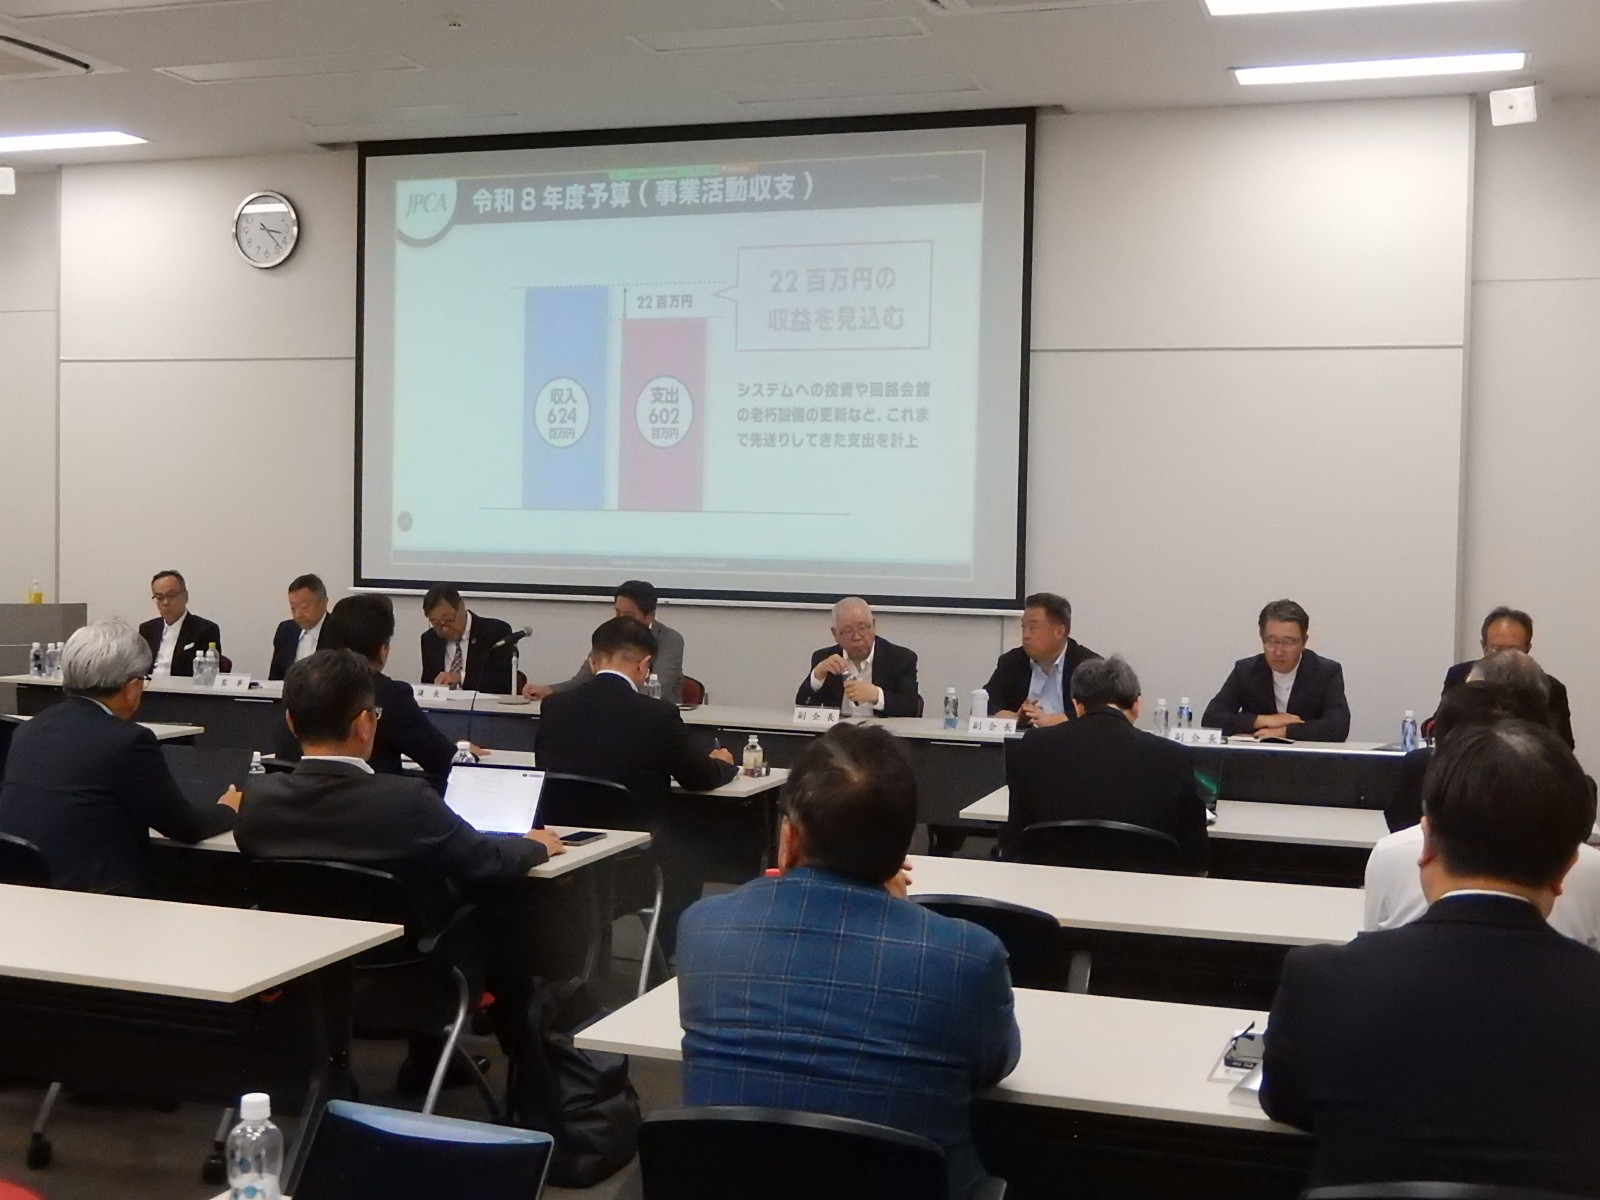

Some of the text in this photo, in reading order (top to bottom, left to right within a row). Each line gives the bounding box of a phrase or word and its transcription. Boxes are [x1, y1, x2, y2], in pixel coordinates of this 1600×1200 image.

[405, 192, 447, 217] JPCA
[767, 306, 904, 333] 収益を見込む
[550, 387, 577, 404] 収入
[651, 387, 679, 404] 支出
[547, 407, 577, 424] 624
[649, 407, 680, 424] 602
[737, 407, 930, 423] の老朽設備の更新など、これま
[549, 427, 576, 440] 百万円
[651, 427, 679, 440] 百万円
[737, 432, 919, 449] で先送りしてきた支出を計上
